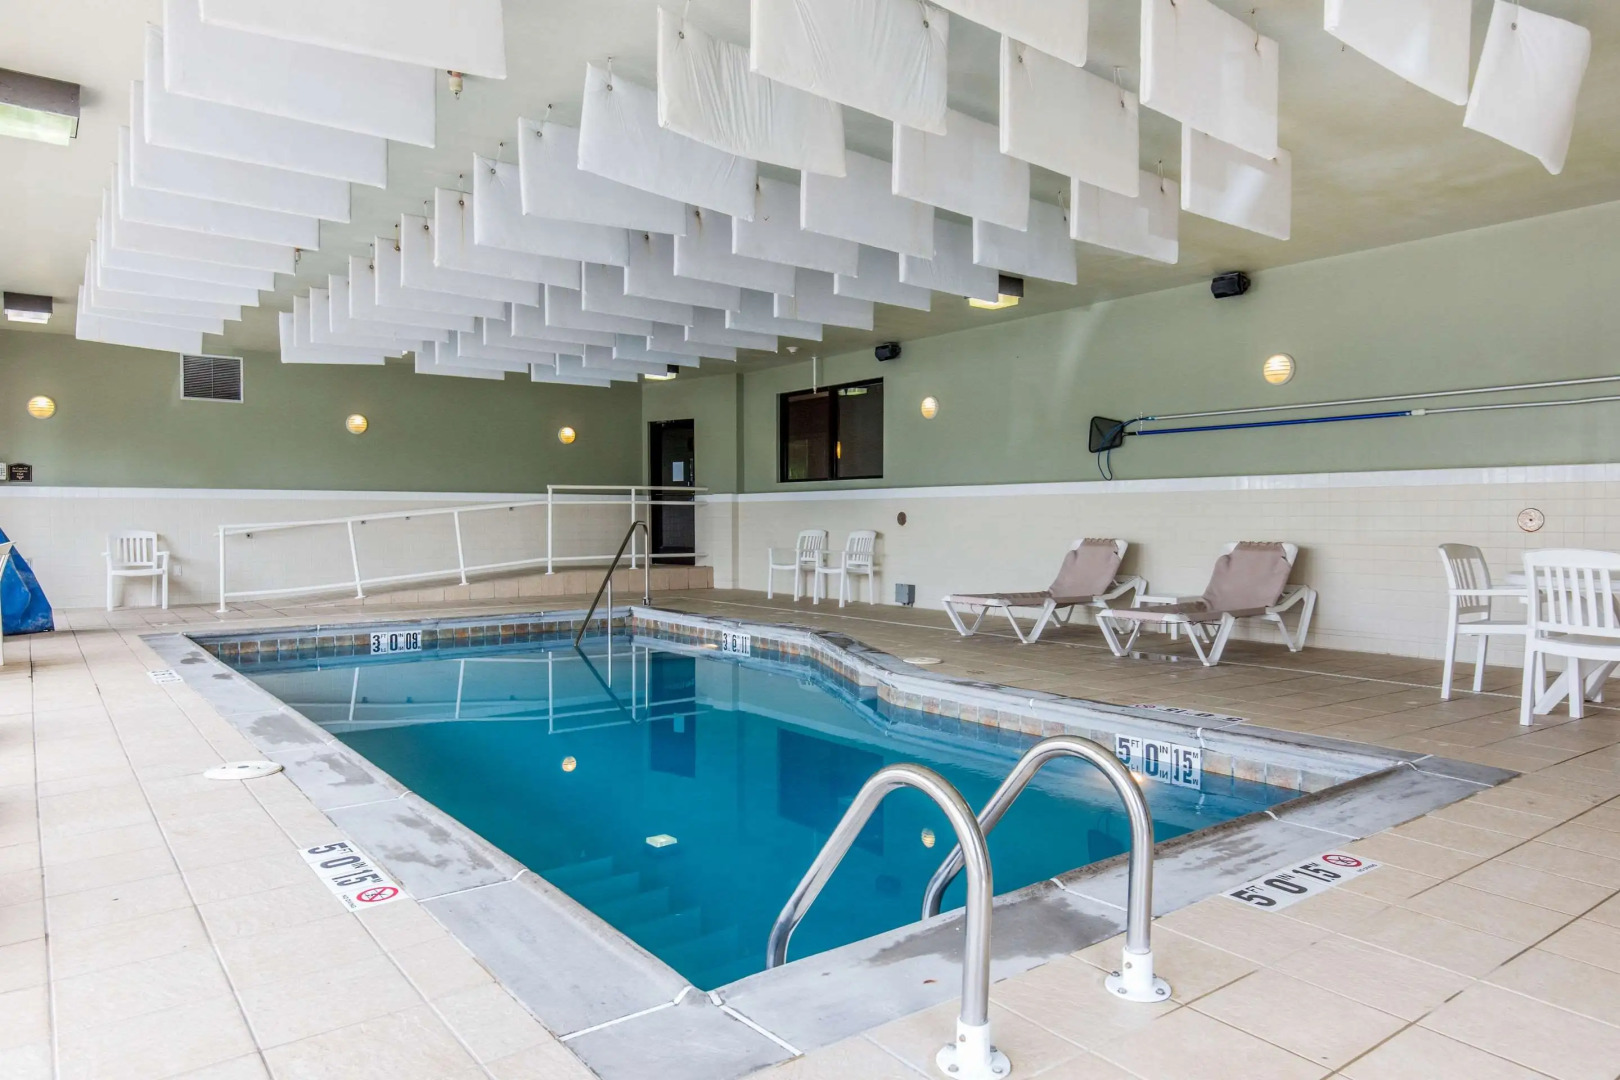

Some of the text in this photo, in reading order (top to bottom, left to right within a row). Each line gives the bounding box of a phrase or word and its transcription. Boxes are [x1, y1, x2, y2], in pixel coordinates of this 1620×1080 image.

[372, 634, 380, 647] 3
[390, 634, 398, 646] 0
[1118, 737, 1131, 762] 5
[1131, 739, 1140, 749] FT
[1145, 743, 1159, 767] 0
[1159, 745, 1169, 755] IN
[308, 842, 349, 855] 5
[320, 855, 361, 869] 0
[1230, 889, 1277, 907] 5
[1263, 878, 1308, 894] 0
